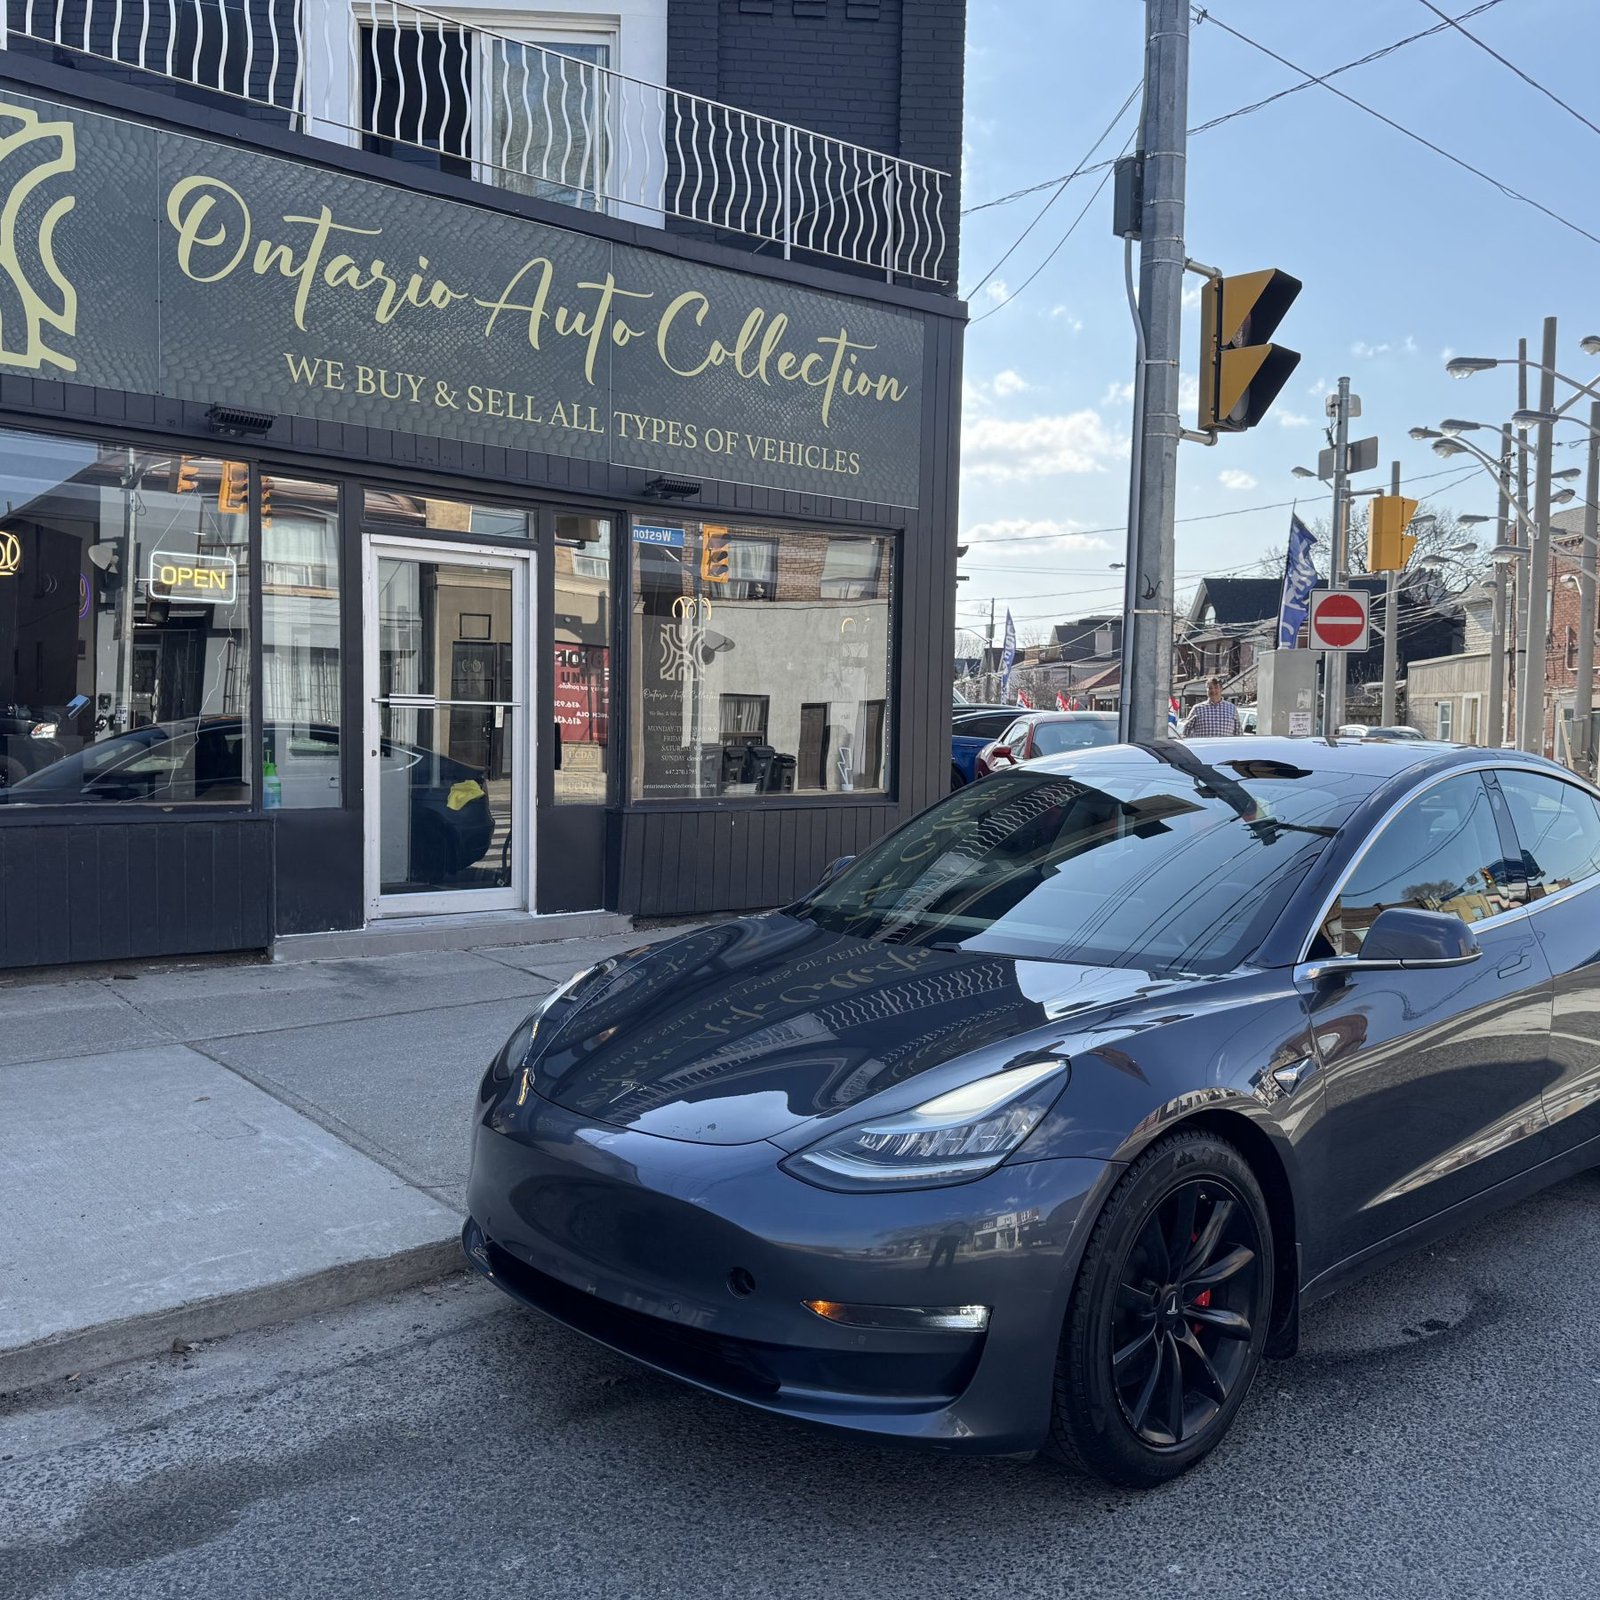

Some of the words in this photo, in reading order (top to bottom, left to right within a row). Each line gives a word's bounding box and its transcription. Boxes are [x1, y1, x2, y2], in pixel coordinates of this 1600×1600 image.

[167, 175, 466, 331] Ontario
[474, 257, 654, 385] Auto
[657, 291, 908, 428] Collection
[283, 352, 346, 390] WE
[355, 365, 426, 404] BUY
[435, 382, 459, 410] &
[466, 385, 543, 424] SELL
[548, 403, 604, 434] ALL
[613, 410, 697, 449] TYPES
[705, 428, 739, 455] OF
[745, 433, 861, 475] VEHICLES
[160, 565, 226, 590] OPEN
[568, 751, 593, 759] UCDA
[661, 754, 685, 762] SUNDAY
